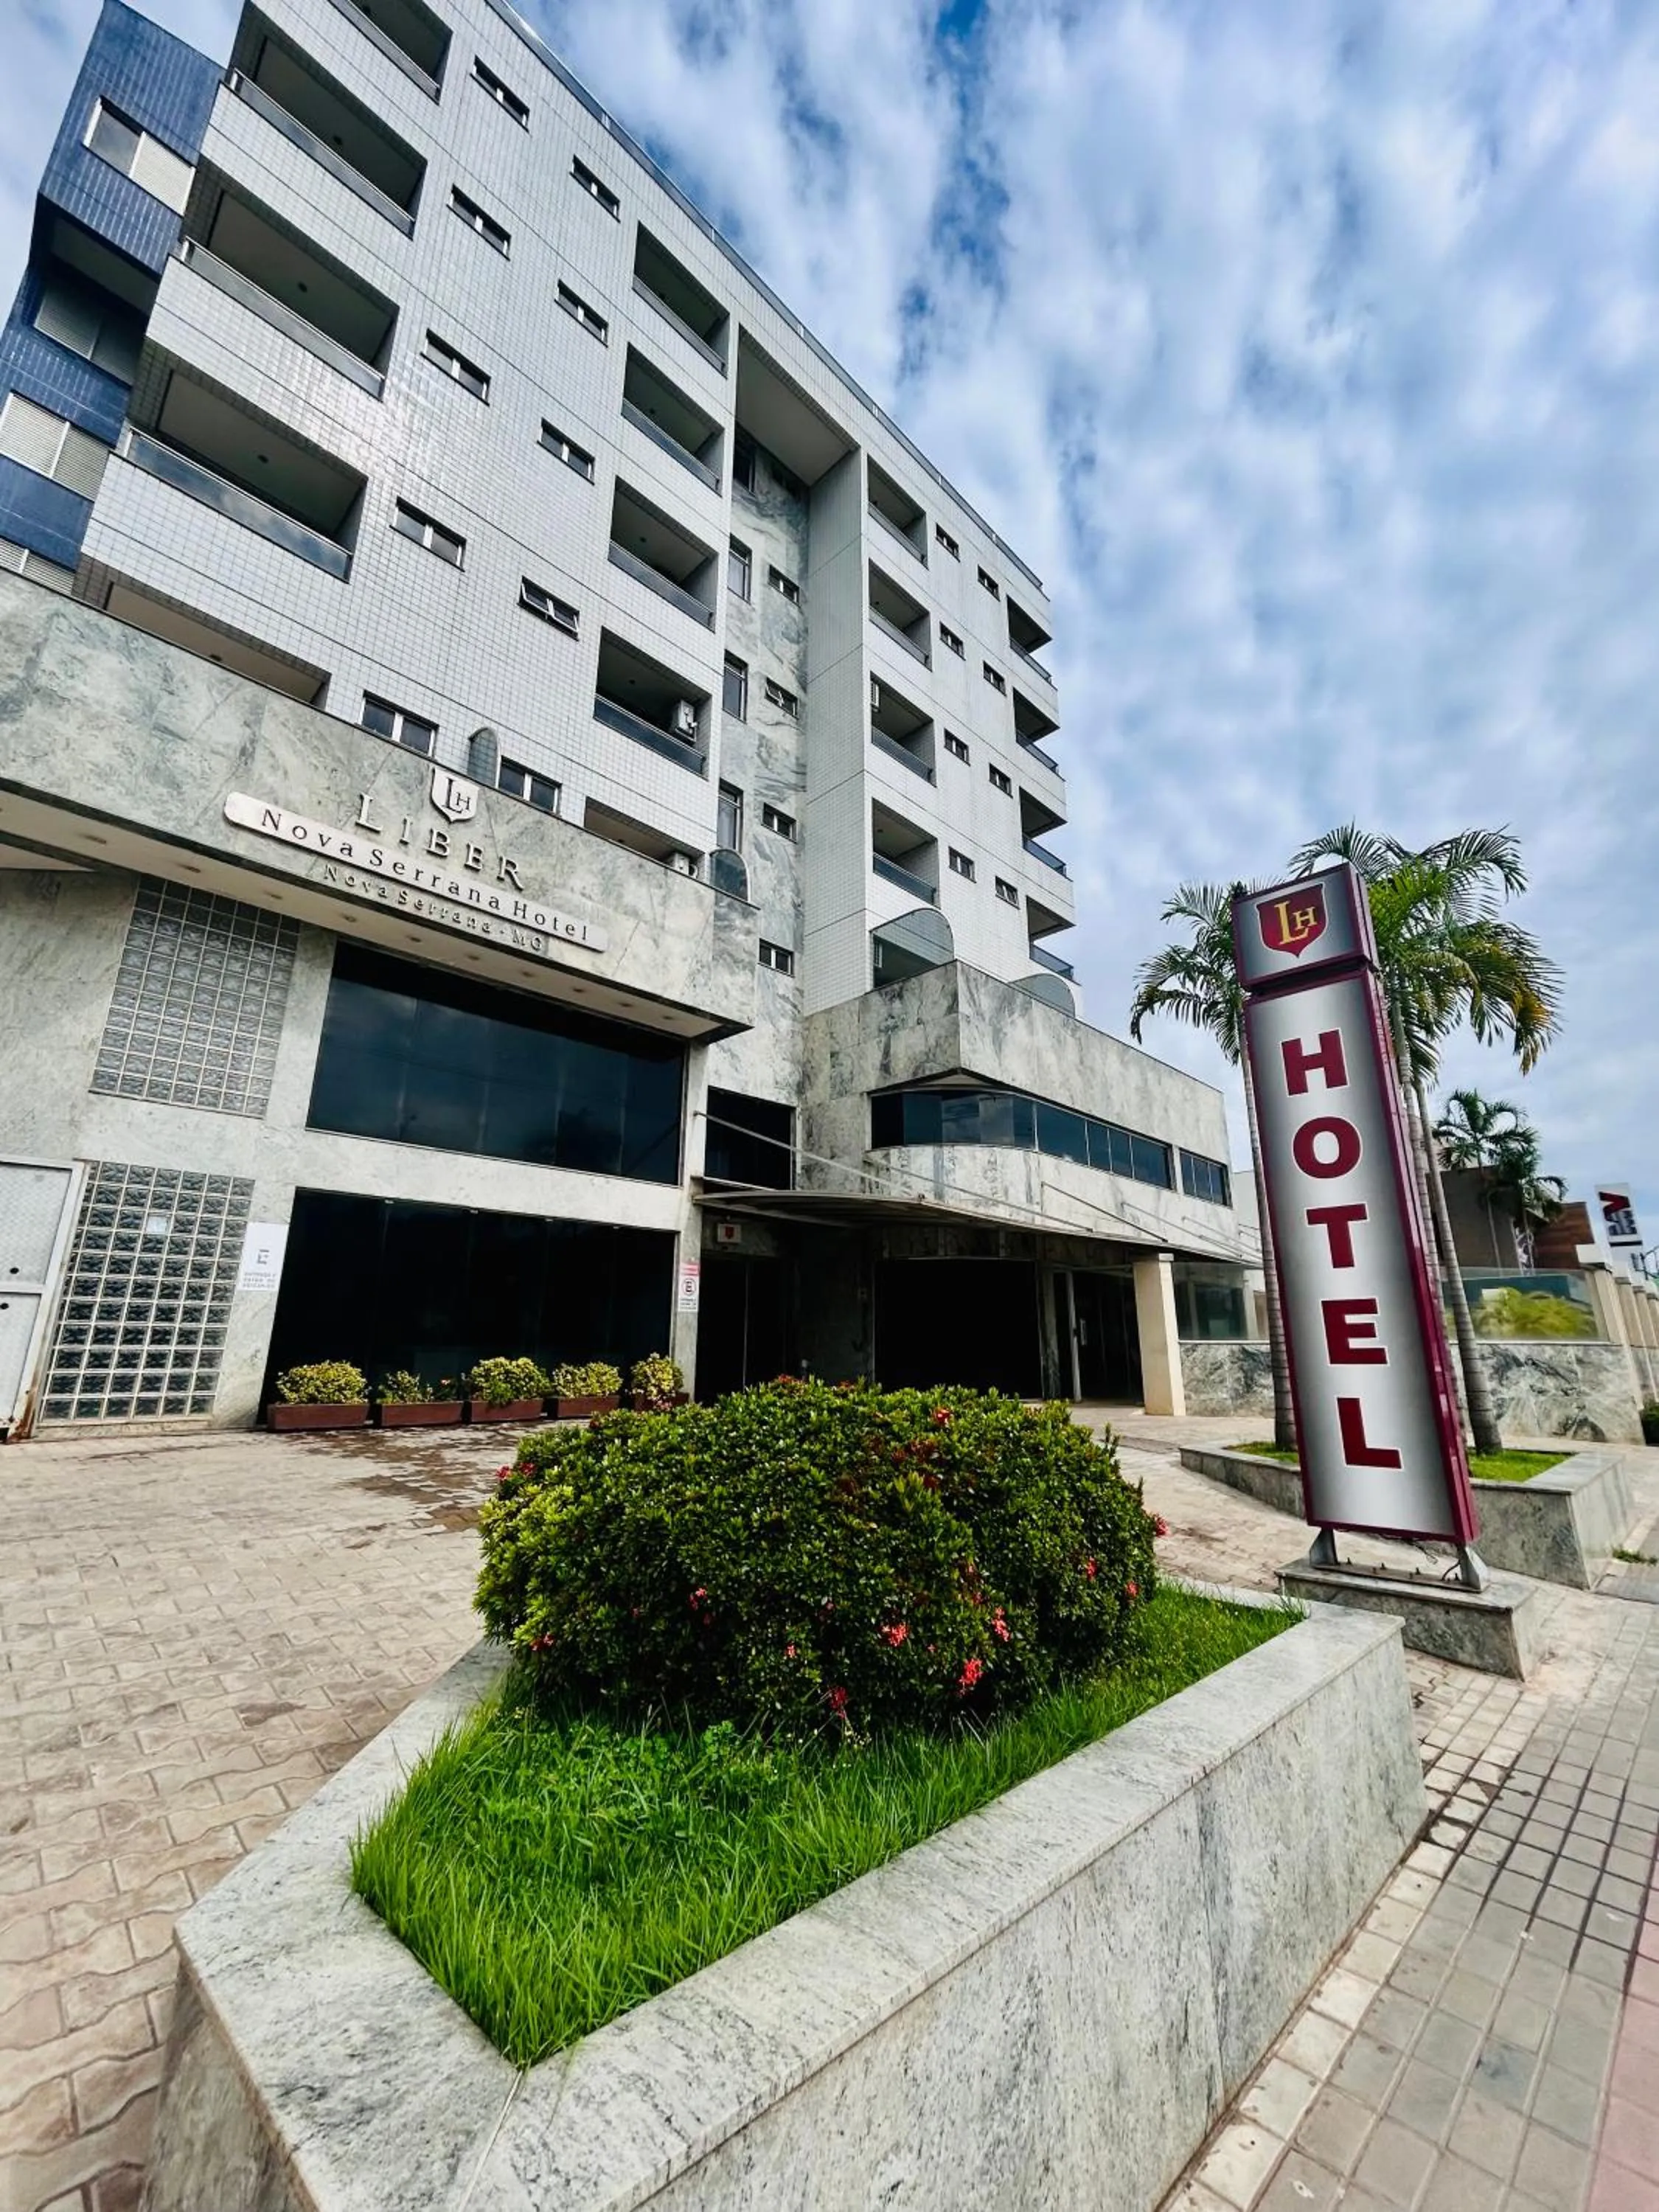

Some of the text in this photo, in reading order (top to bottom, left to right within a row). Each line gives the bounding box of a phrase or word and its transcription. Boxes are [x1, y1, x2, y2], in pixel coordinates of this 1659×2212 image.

[261, 808, 588, 941] Nova Serrana Hotel
[355, 793, 525, 891] LIBER
[324, 863, 389, 899] Nova
[397, 889, 490, 933] Serrana
[512, 928, 543, 952] MG
[1280, 1027, 1402, 1470] HOTEL
